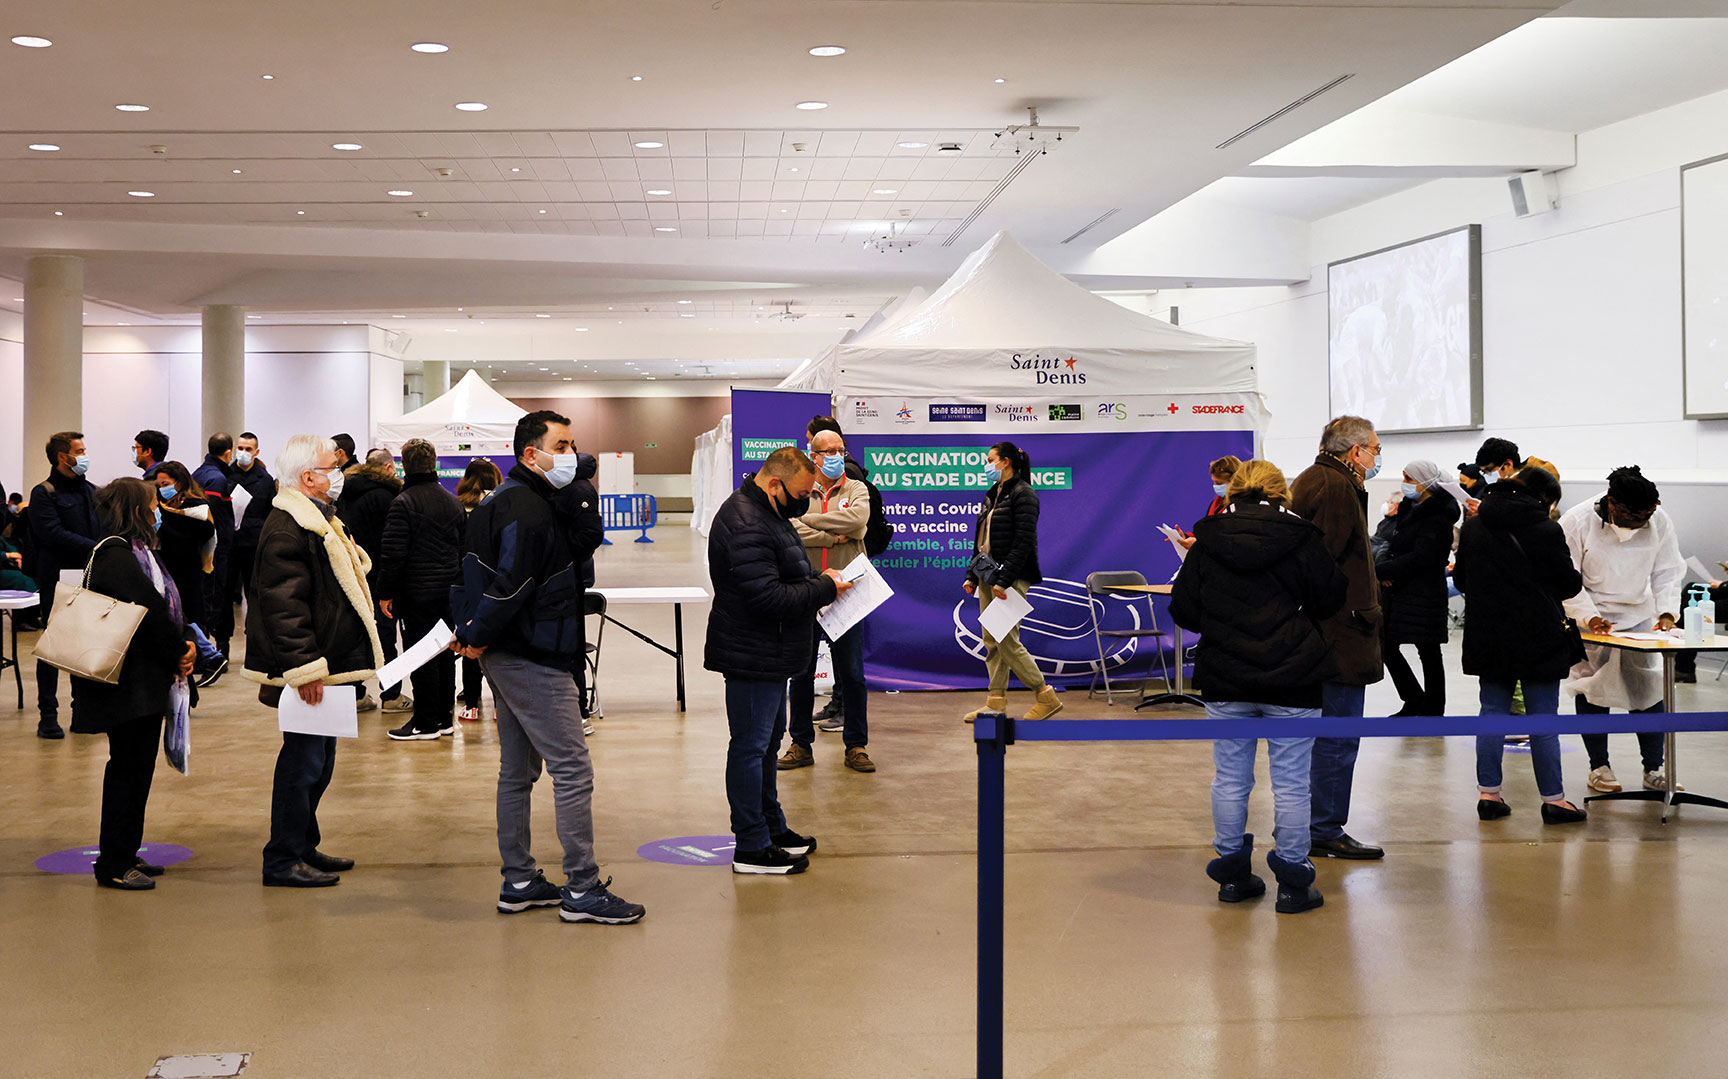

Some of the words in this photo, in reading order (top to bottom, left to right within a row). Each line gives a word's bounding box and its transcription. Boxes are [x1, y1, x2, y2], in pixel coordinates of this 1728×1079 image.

[1010, 353, 1060, 370] Saint
[1036, 370, 1086, 385] Denis
[994, 403, 1024, 414] Saint
[1009, 413, 1039, 422] Denis
[871, 452, 988, 466] VACCINATION
[872, 472, 897, 486] AU
[901, 472, 959, 486] STADE
[964, 472, 988, 486] DE
[921, 502, 934, 515] la
[938, 502, 982, 515] Covid
[910, 520, 968, 533] vaccine
